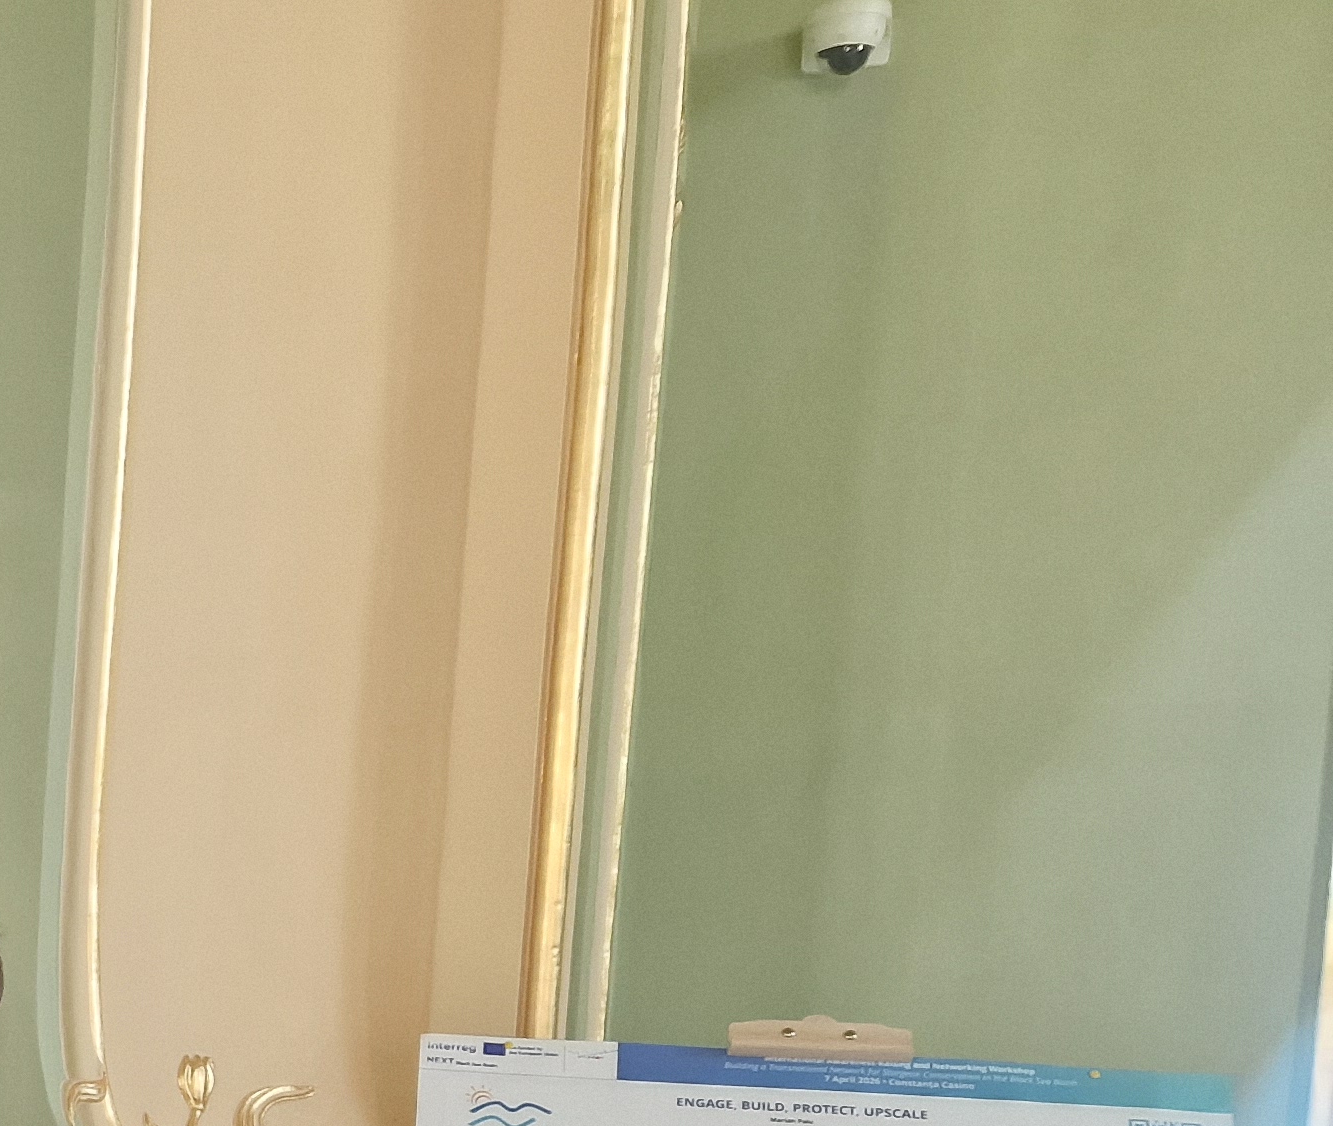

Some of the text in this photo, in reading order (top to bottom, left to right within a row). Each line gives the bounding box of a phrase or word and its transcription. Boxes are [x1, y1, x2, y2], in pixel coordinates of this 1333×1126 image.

[426, 1056, 455, 1064] NEXT
[832, 1075, 856, 1085] April
[858, 1077, 881, 1085] 2026
[676, 1097, 929, 1120] ENGAGE, BUILD, PROTECT, UPSCALE
